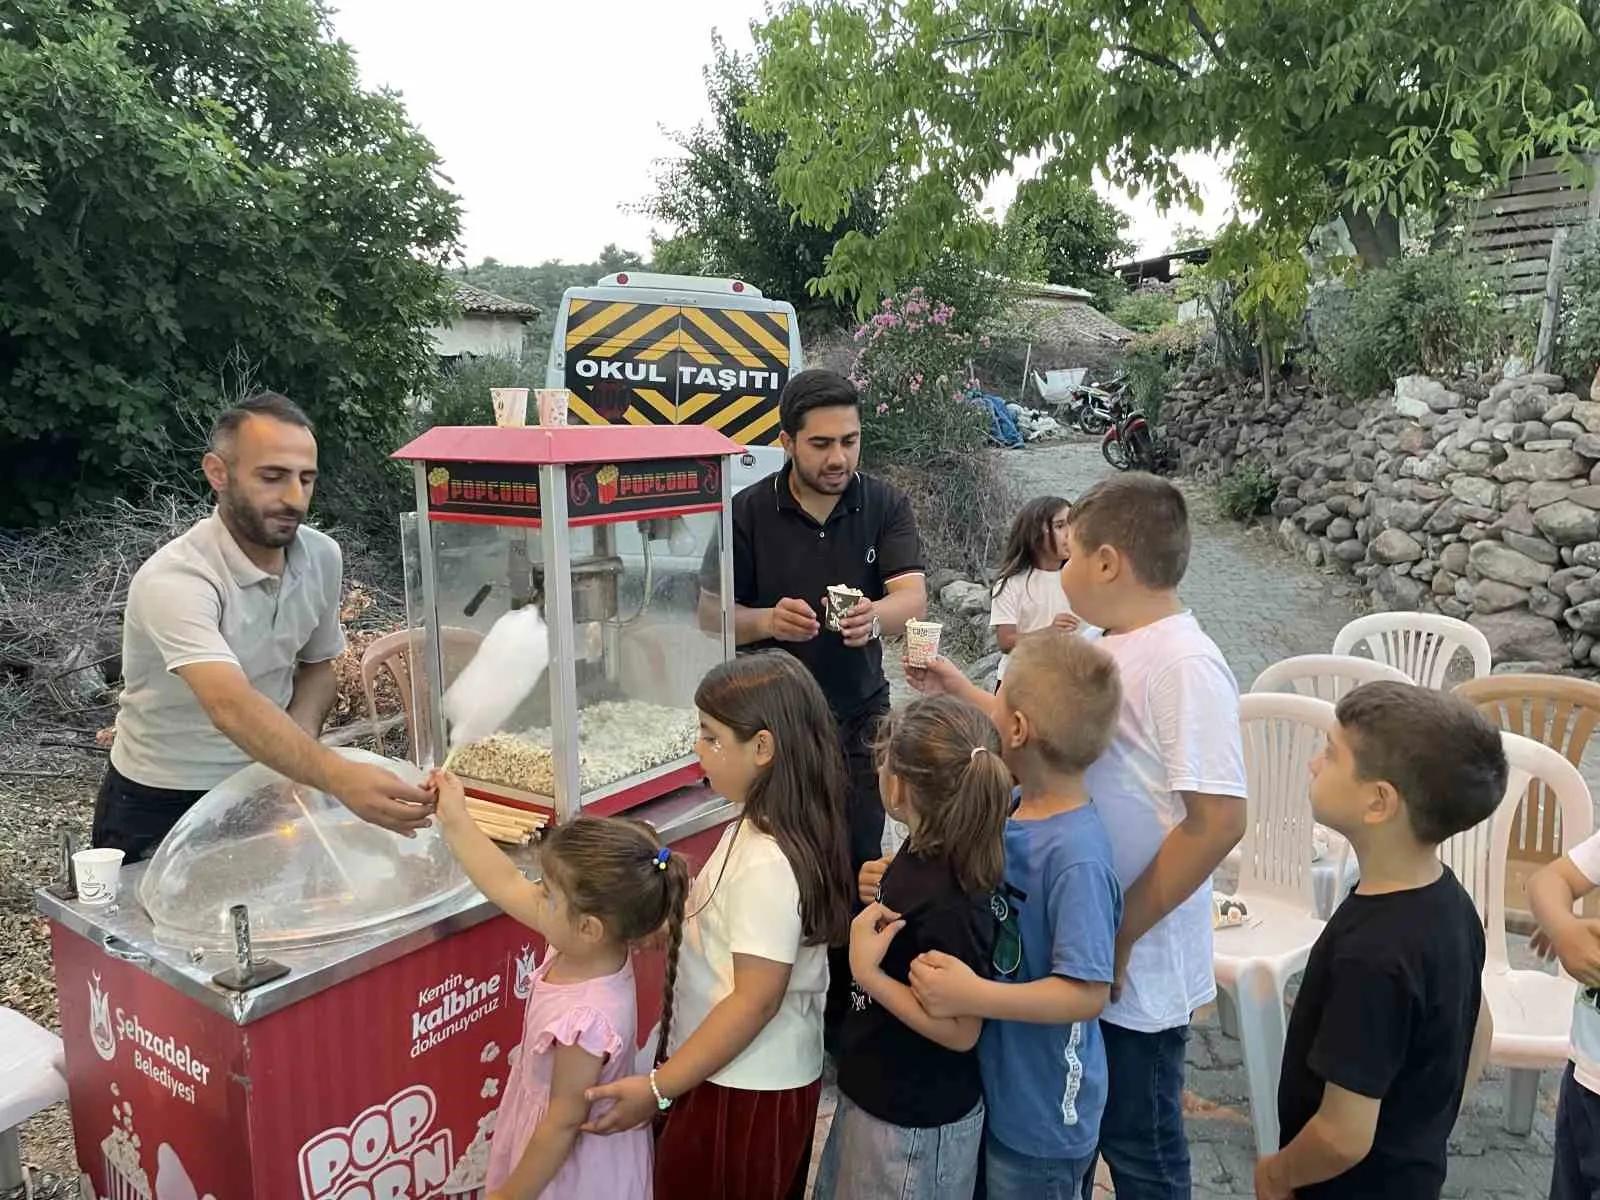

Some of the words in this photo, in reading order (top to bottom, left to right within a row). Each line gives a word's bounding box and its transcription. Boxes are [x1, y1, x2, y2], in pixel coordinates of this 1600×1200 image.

[575, 359, 667, 383] OKUL
[678, 366, 779, 391] TAŞITI
[412, 974, 500, 1040] kalbine
[418, 973, 462, 1008] Kentin
[115, 1007, 210, 1086] Şehzadeler
[410, 997, 500, 1058] dokunuyoruz
[134, 1049, 195, 1105] Belediyesi
[303, 1090, 432, 1198] POP
